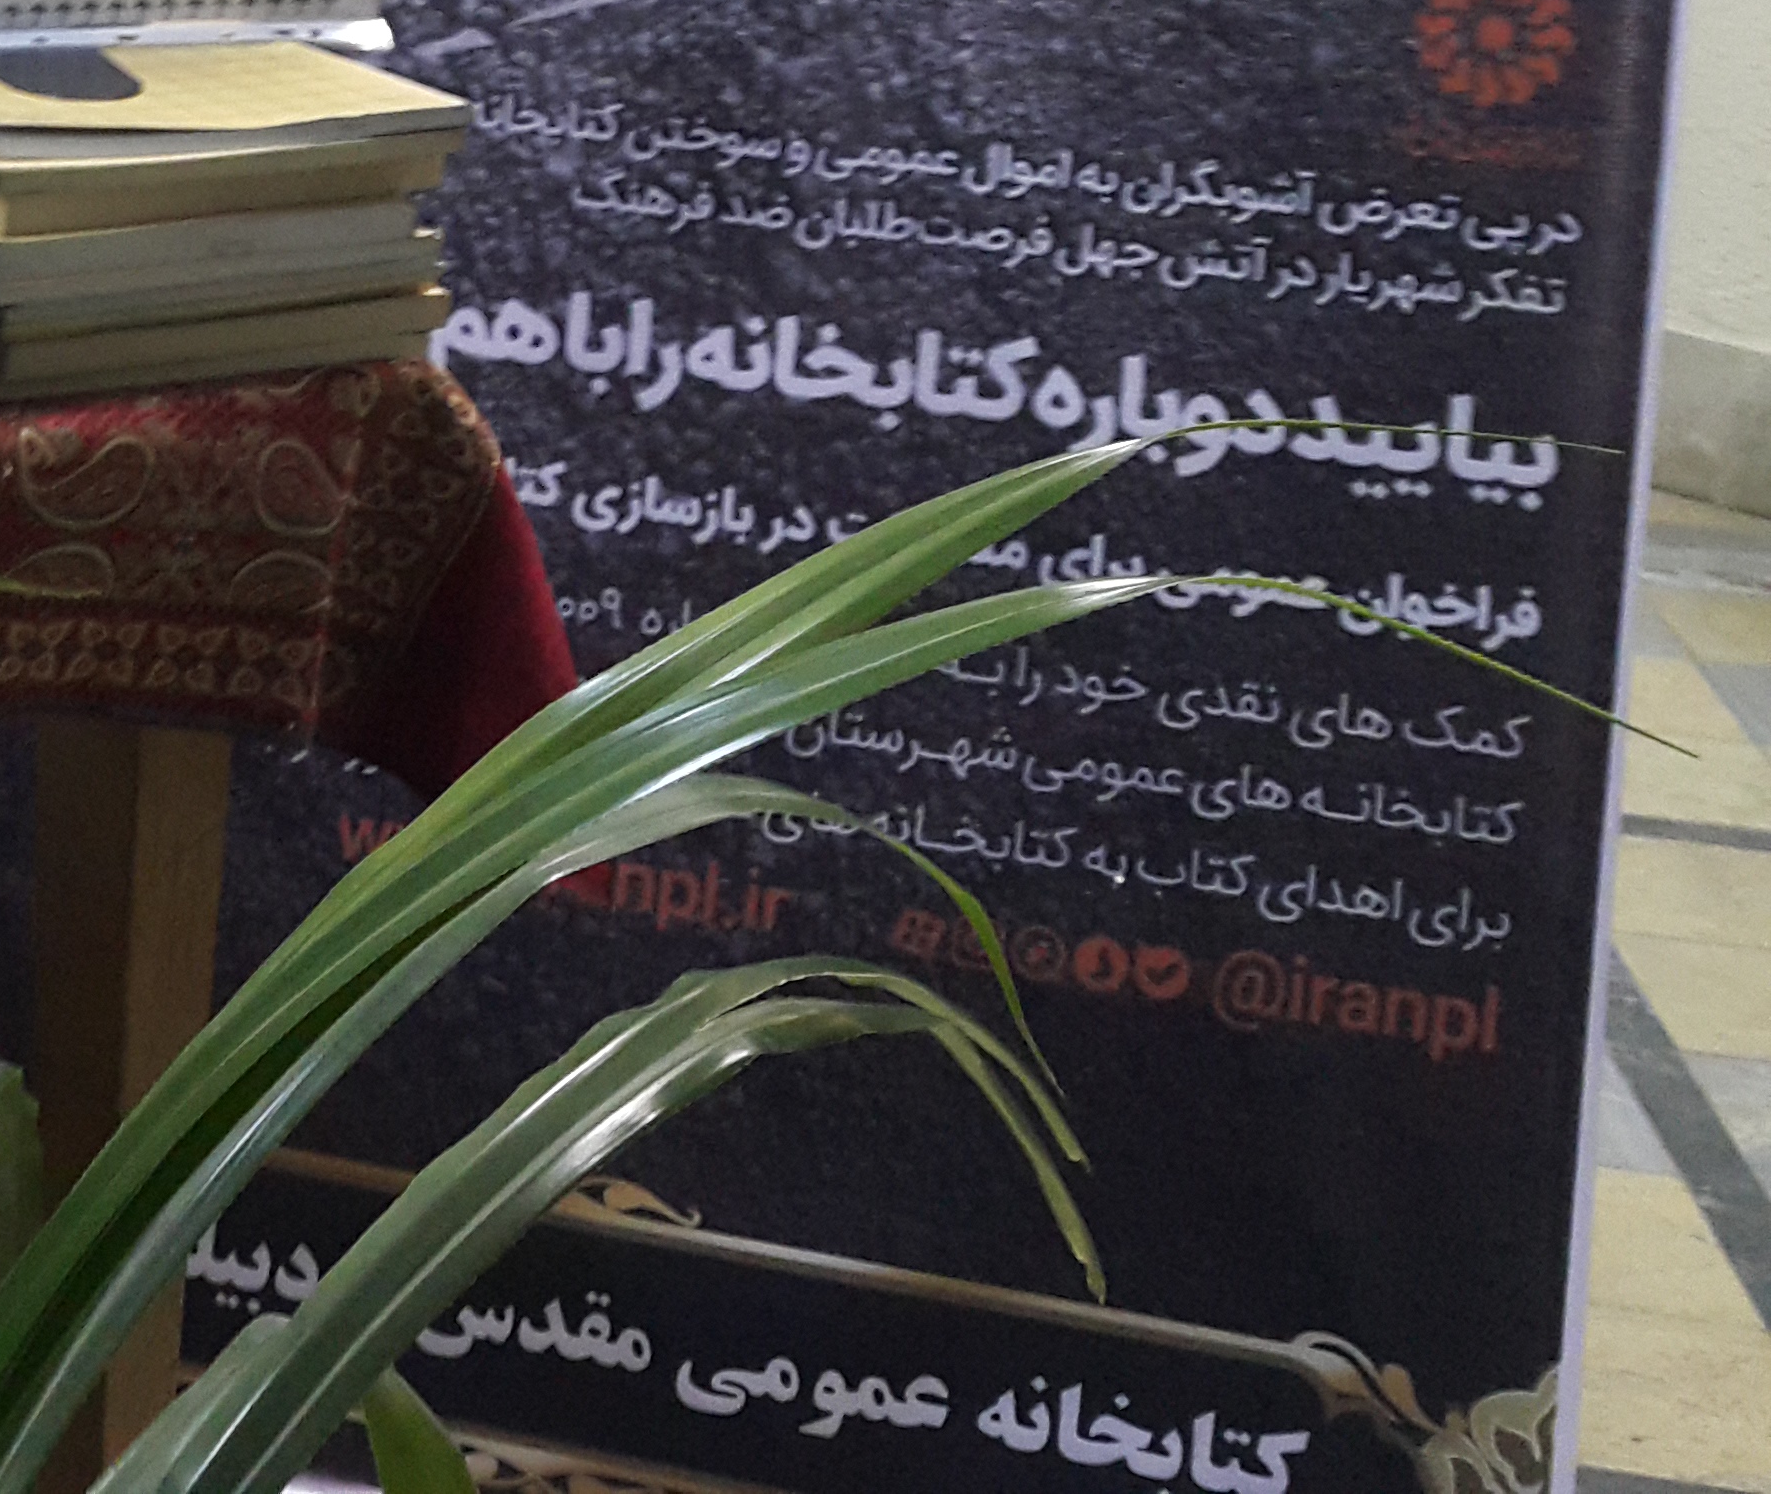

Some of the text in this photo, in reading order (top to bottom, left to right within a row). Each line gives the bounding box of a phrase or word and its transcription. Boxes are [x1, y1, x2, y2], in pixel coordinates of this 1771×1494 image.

[621, 114, 781, 171] سوختن
[781, 137, 813, 178] و
[814, 144, 961, 187] عمومی
[571, 167, 717, 233] فرهنگ
[1076, 159, 1121, 204] به
[717, 195, 793, 231] ضد
[1318, 189, 1460, 241] تعرض
[1057, 224, 1160, 280] جهل
[1159, 235, 1271, 291] آتش
[1267, 257, 1318, 301] در
[1314, 251, 1461, 315] شهریار
[1459, 268, 1568, 322] تفکر
[426, 295, 560, 374] هم
[559, 289, 622, 398] با
[685, 312, 1041, 433] کتابخانه
[1033, 353, 1287, 478] دوباره
[1287, 392, 1560, 511] بیایید
[570, 475, 757, 546] بازسازی
[758, 505, 818, 554] در
[1337, 572, 1542, 653] فراخوان
[1015, 645, 1044, 706] را
[1055, 664, 1150, 715] خود
[1155, 679, 1281, 730] نقدی
[784, 711, 1018, 780] شهرستان
[1021, 756, 1185, 803] عمومی
[1081, 843, 1129, 887] به
[1135, 847, 1257, 898] کتاب
[1259, 862, 1405, 924] اهدای
[1407, 884, 1513, 952] برای
[1213, 946, 1502, 1064] @iranpl
[412, 1289, 654, 1373] مقدس
[674, 1352, 951, 1441] عمومی
[975, 1374, 1312, 1494] کتابخانه
